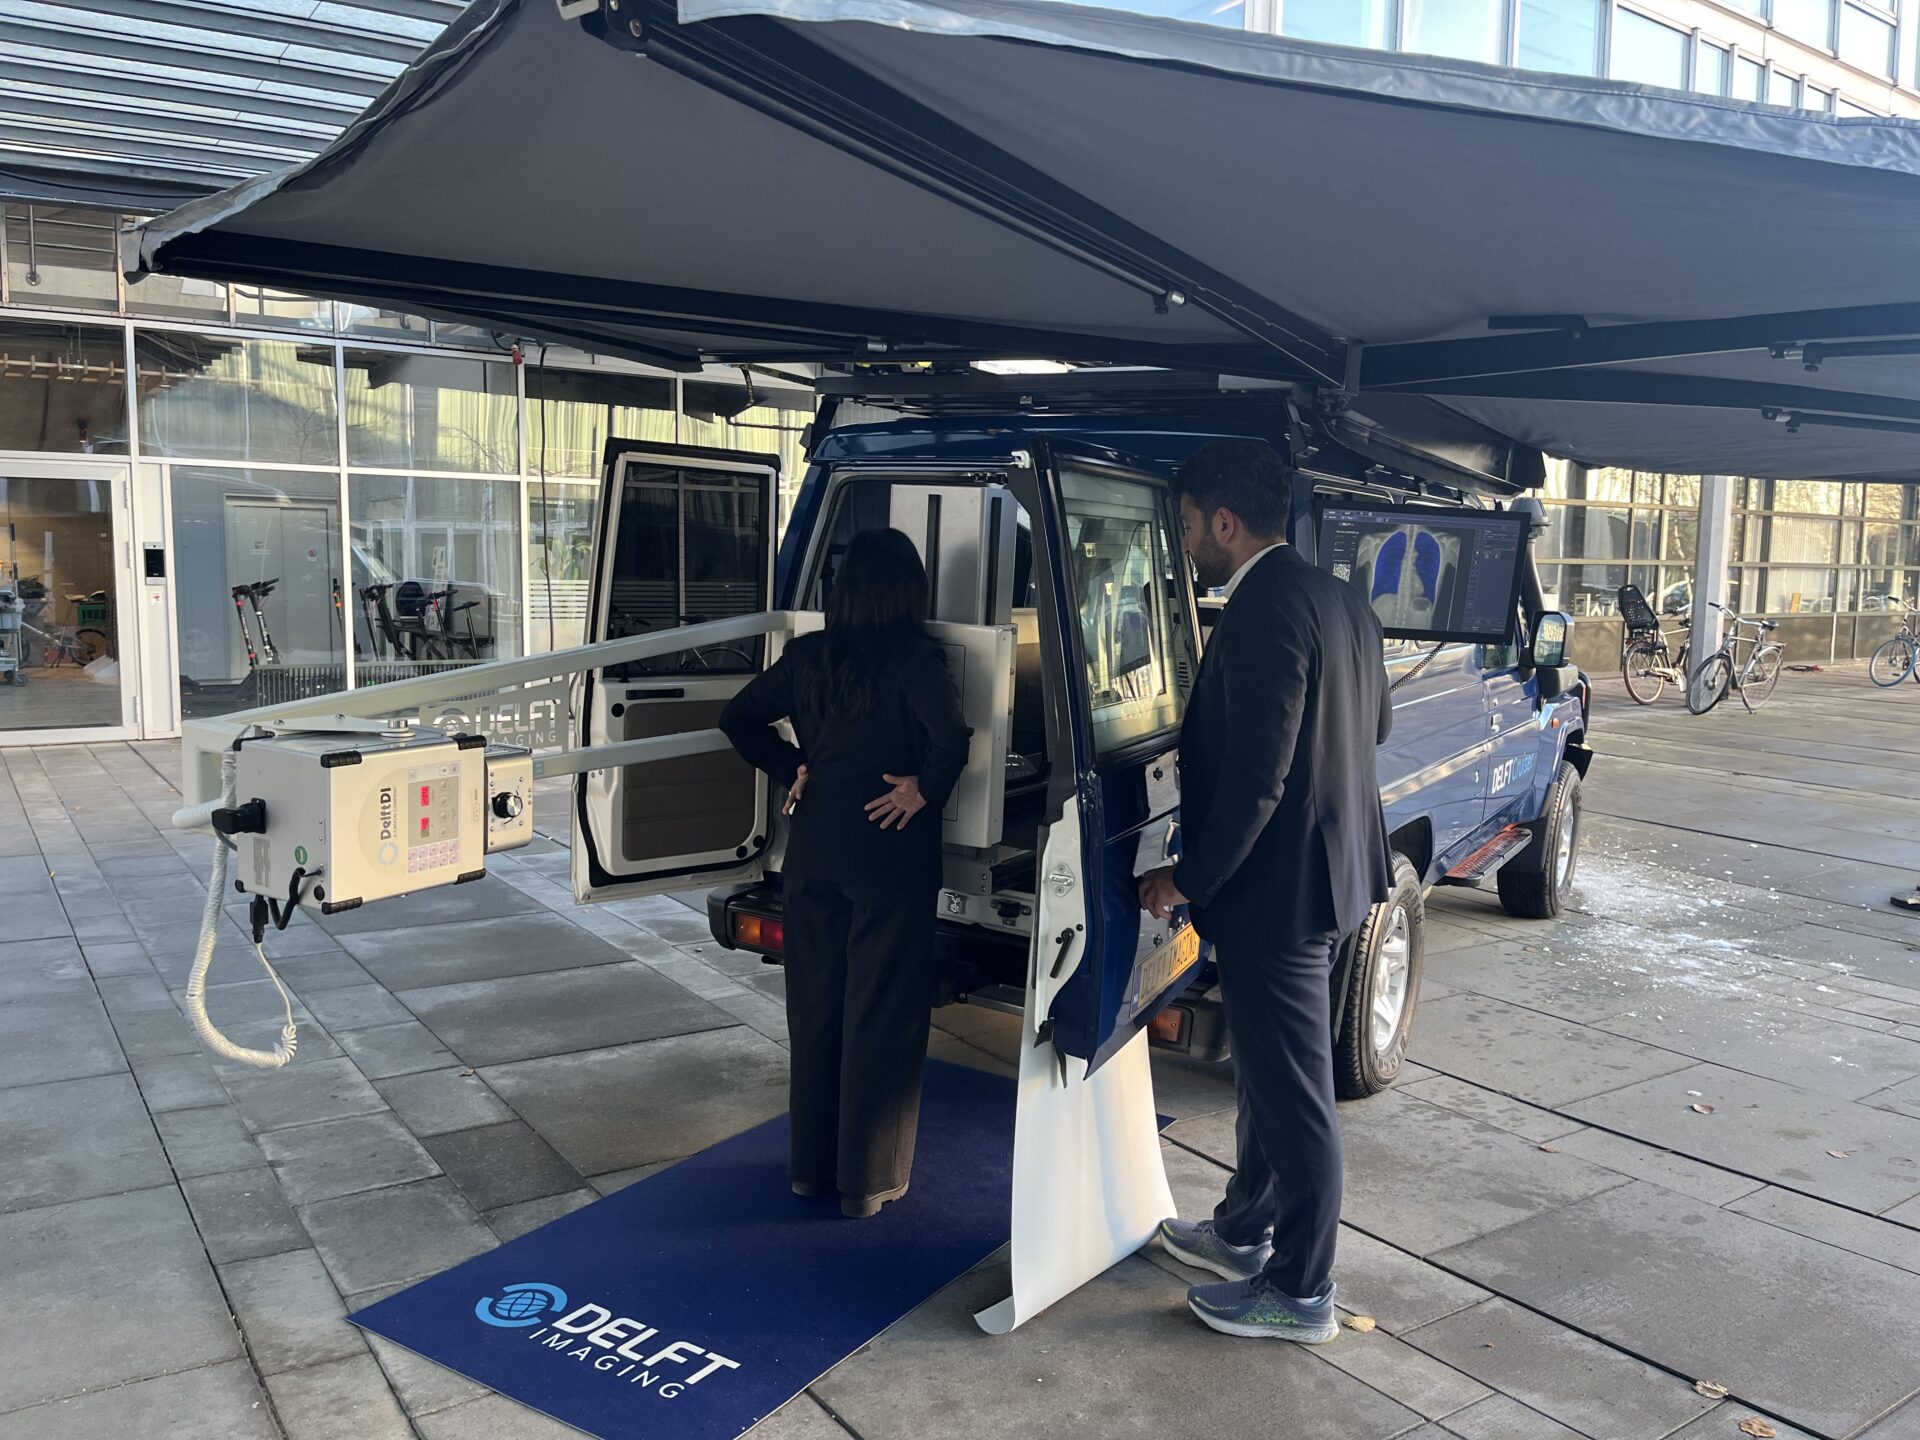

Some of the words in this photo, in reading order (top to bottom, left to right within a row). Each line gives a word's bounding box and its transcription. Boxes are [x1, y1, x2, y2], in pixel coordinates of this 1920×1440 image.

[475, 699, 561, 736] DELFT
[1491, 758, 1514, 794] DELFT
[380, 787, 392, 841] DelftDI
[529, 1327, 686, 1399] IMAGING
[551, 1303, 742, 1385] DELFT
